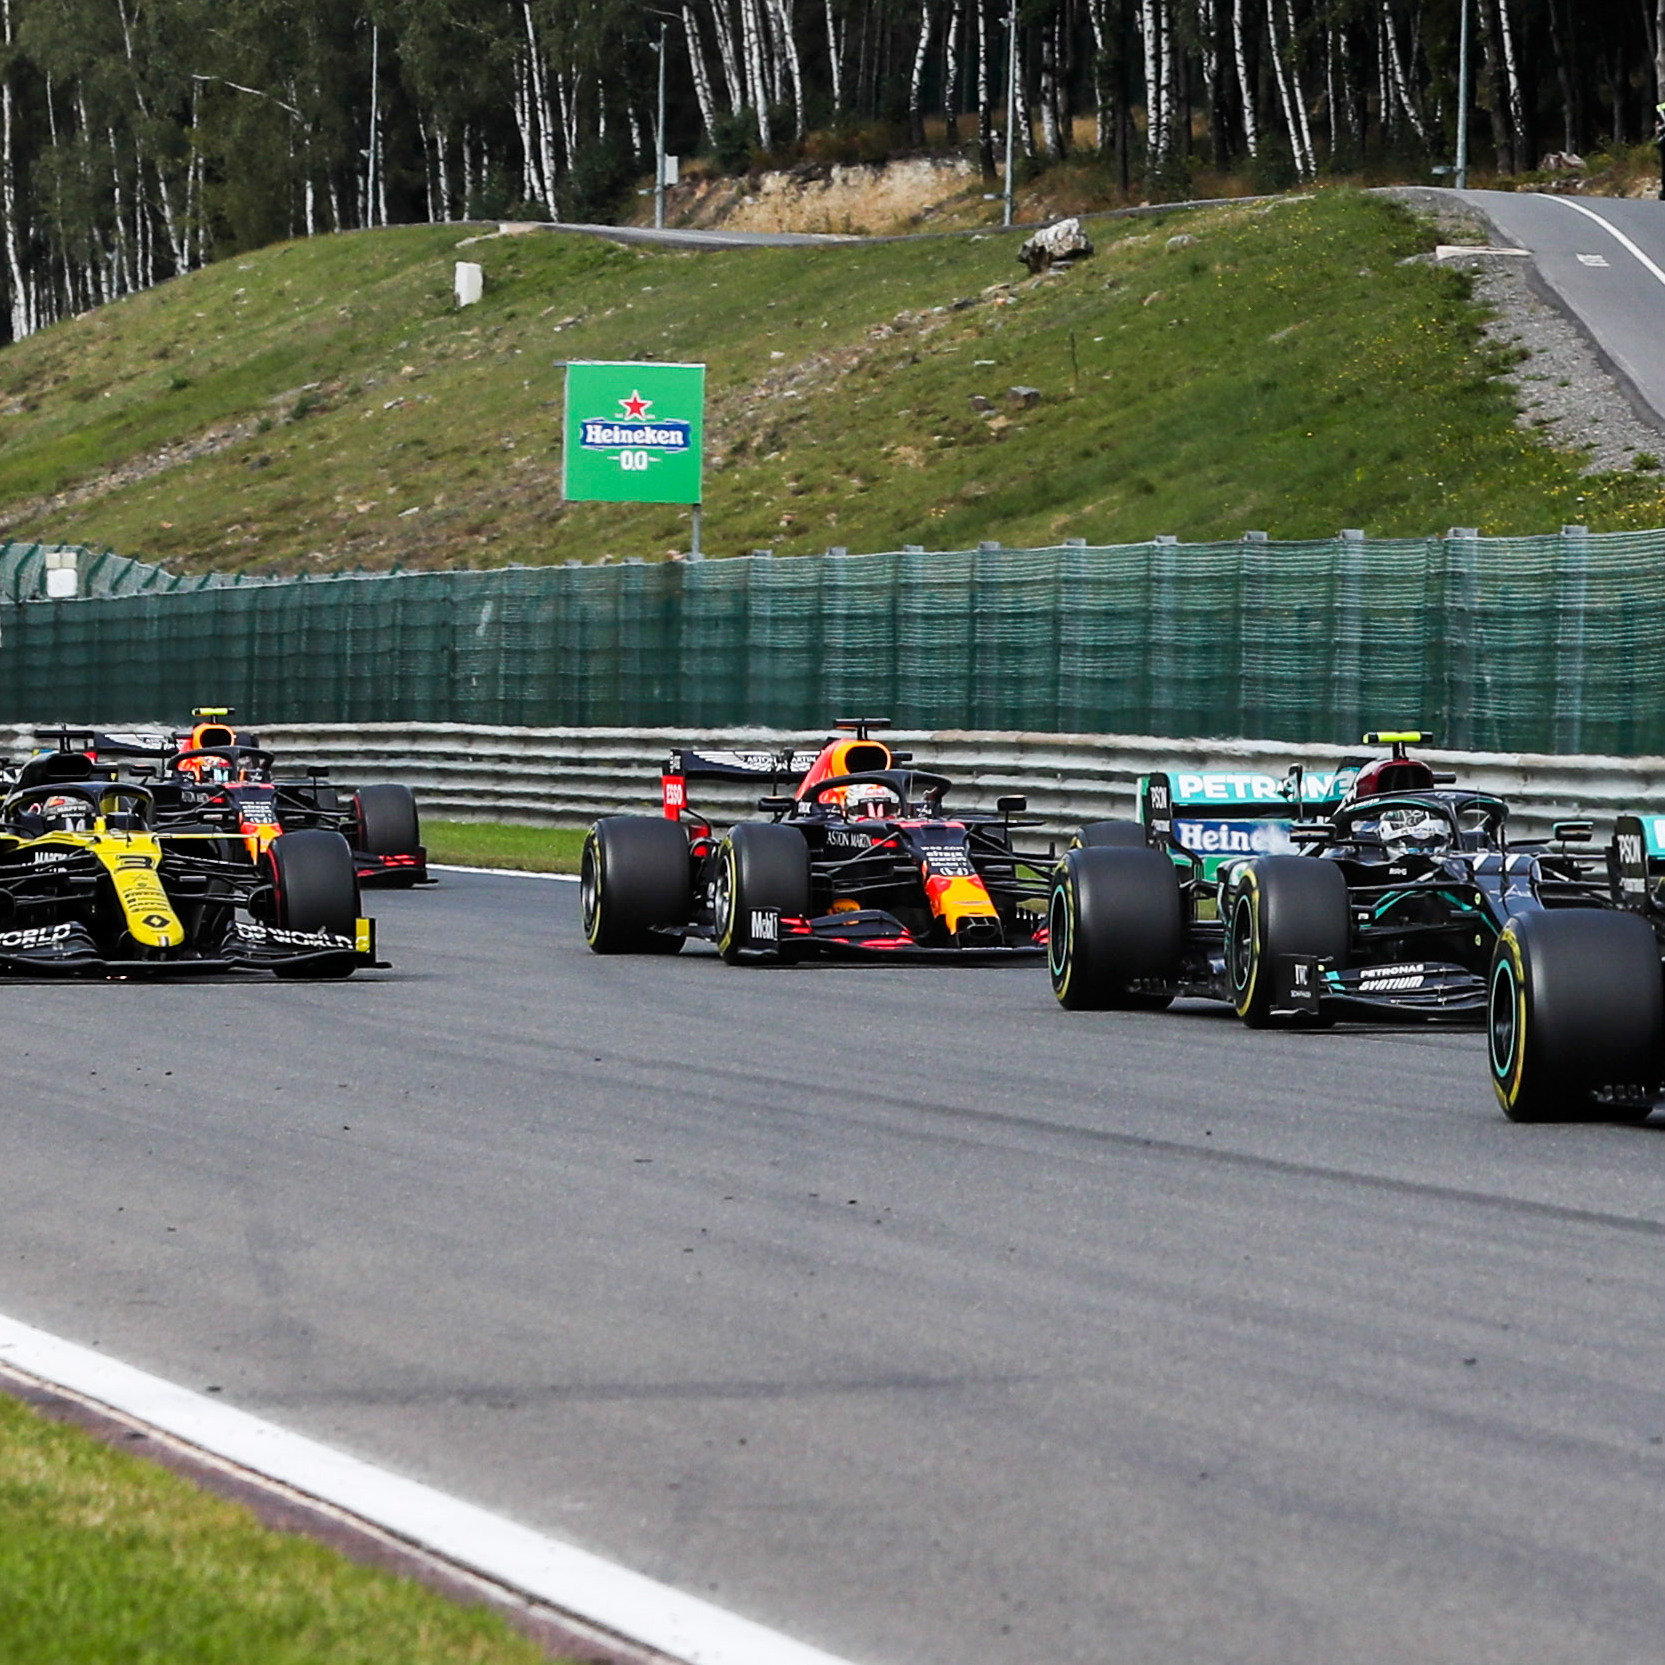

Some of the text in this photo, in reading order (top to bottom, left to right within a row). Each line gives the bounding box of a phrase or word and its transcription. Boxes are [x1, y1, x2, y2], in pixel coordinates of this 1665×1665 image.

[586, 424, 684, 446] Heineken
[114, 854, 156, 873] 3
[1360, 964, 1425, 979] PETRONAS
[1358, 975, 1425, 991] SYNTIUM
